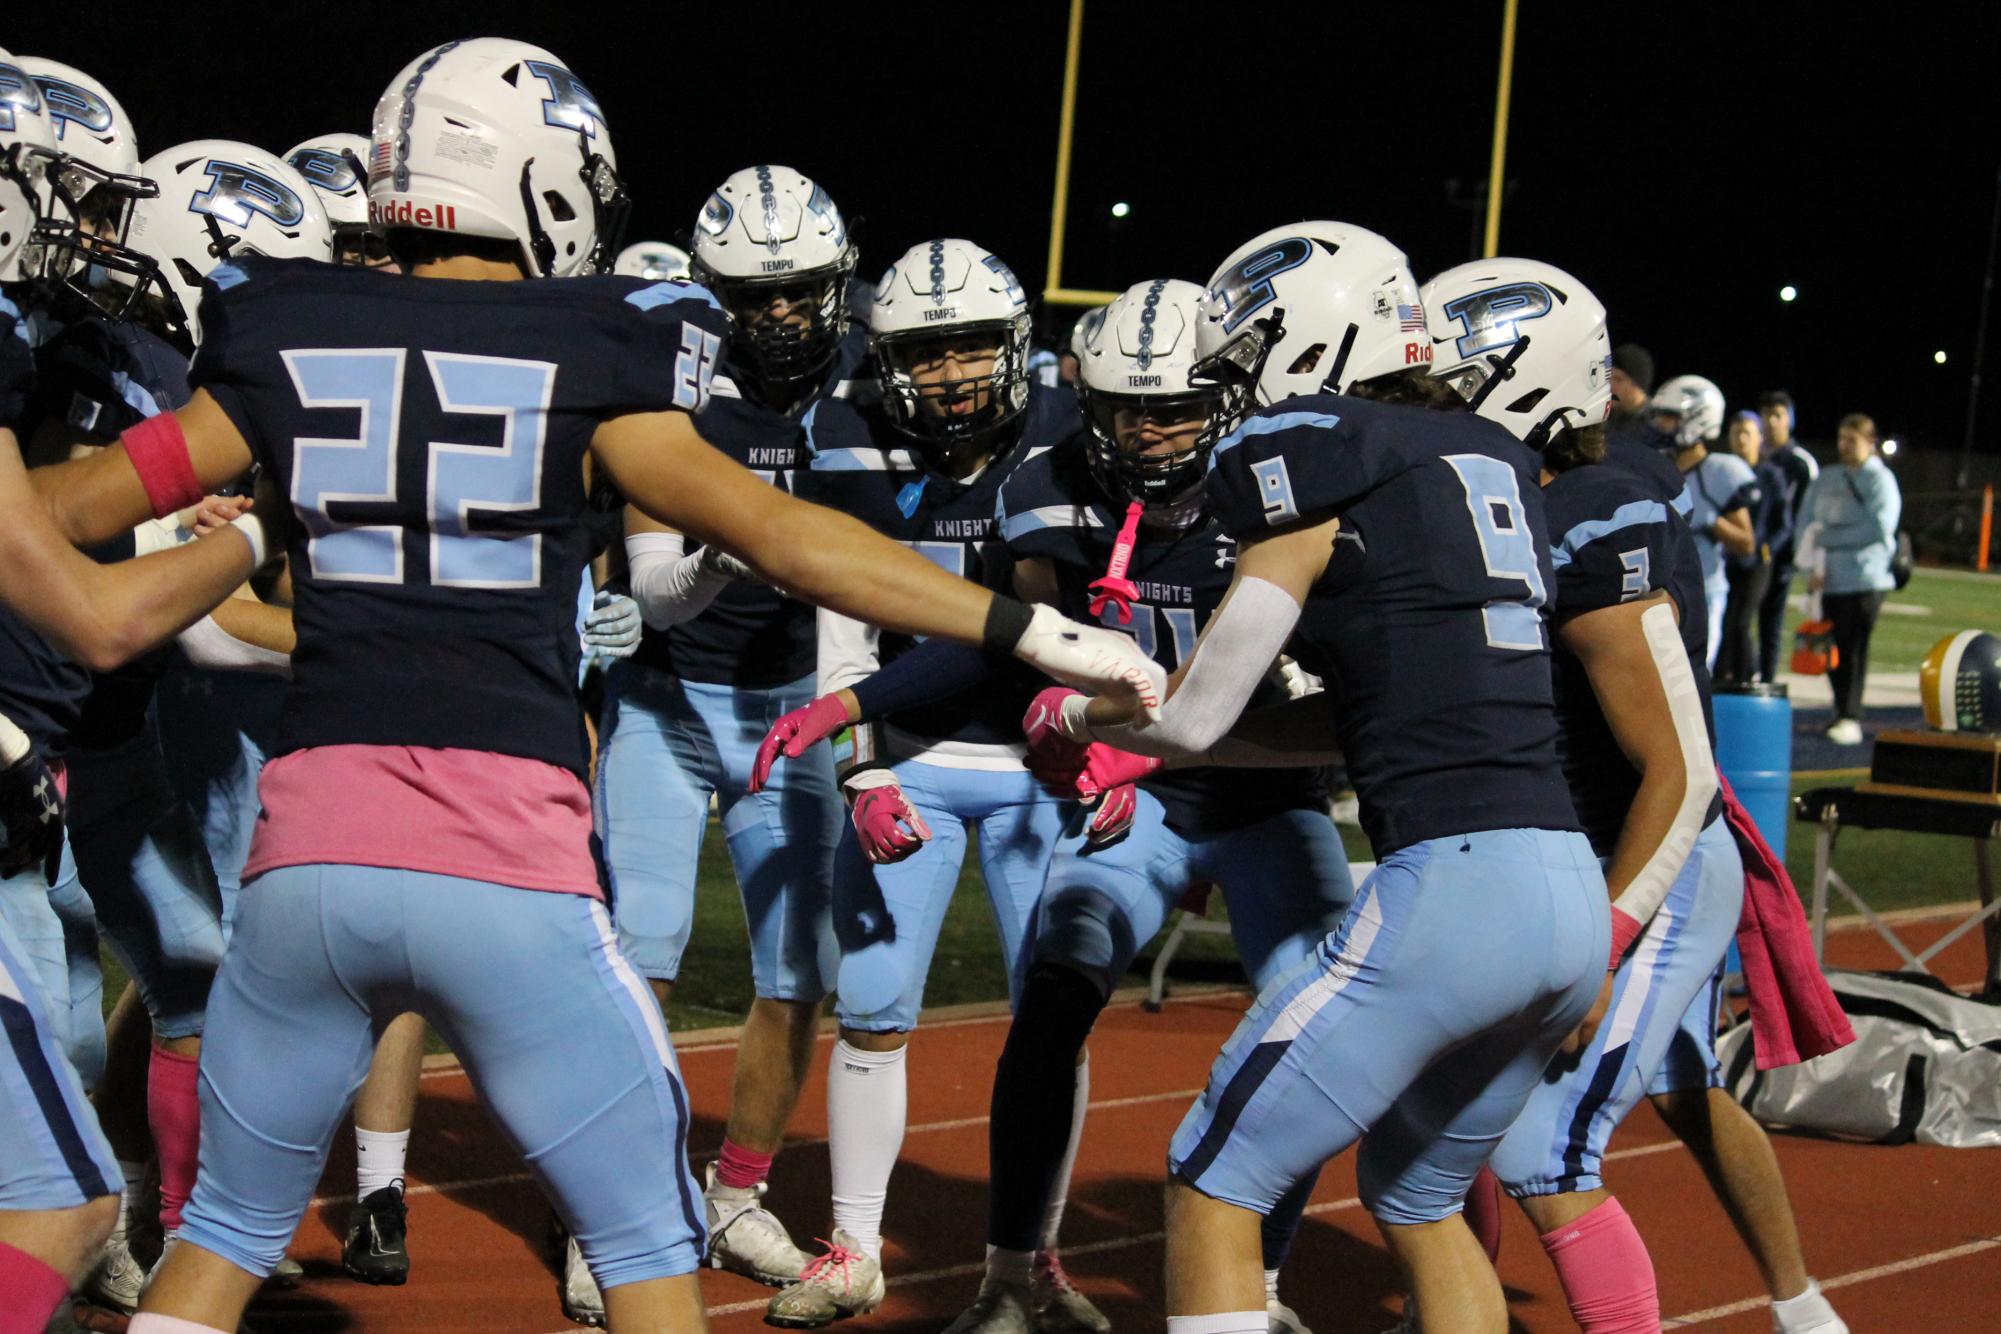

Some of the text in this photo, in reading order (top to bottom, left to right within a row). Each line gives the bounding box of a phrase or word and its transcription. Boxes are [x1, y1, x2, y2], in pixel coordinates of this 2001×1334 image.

[524, 60, 608, 140] P
[189, 159, 304, 229] P
[369, 199, 456, 230] Riddell
[1210, 236, 1313, 335] P
[1443, 281, 1553, 360] P
[671, 320, 722, 414] 22
[1128, 375, 1162, 387] TEMPO
[279, 347, 558, 588] 22
[1250, 455, 1300, 526] 9
[1438, 453, 1551, 651] 9
[1136, 581, 1193, 603] NIGHTS
